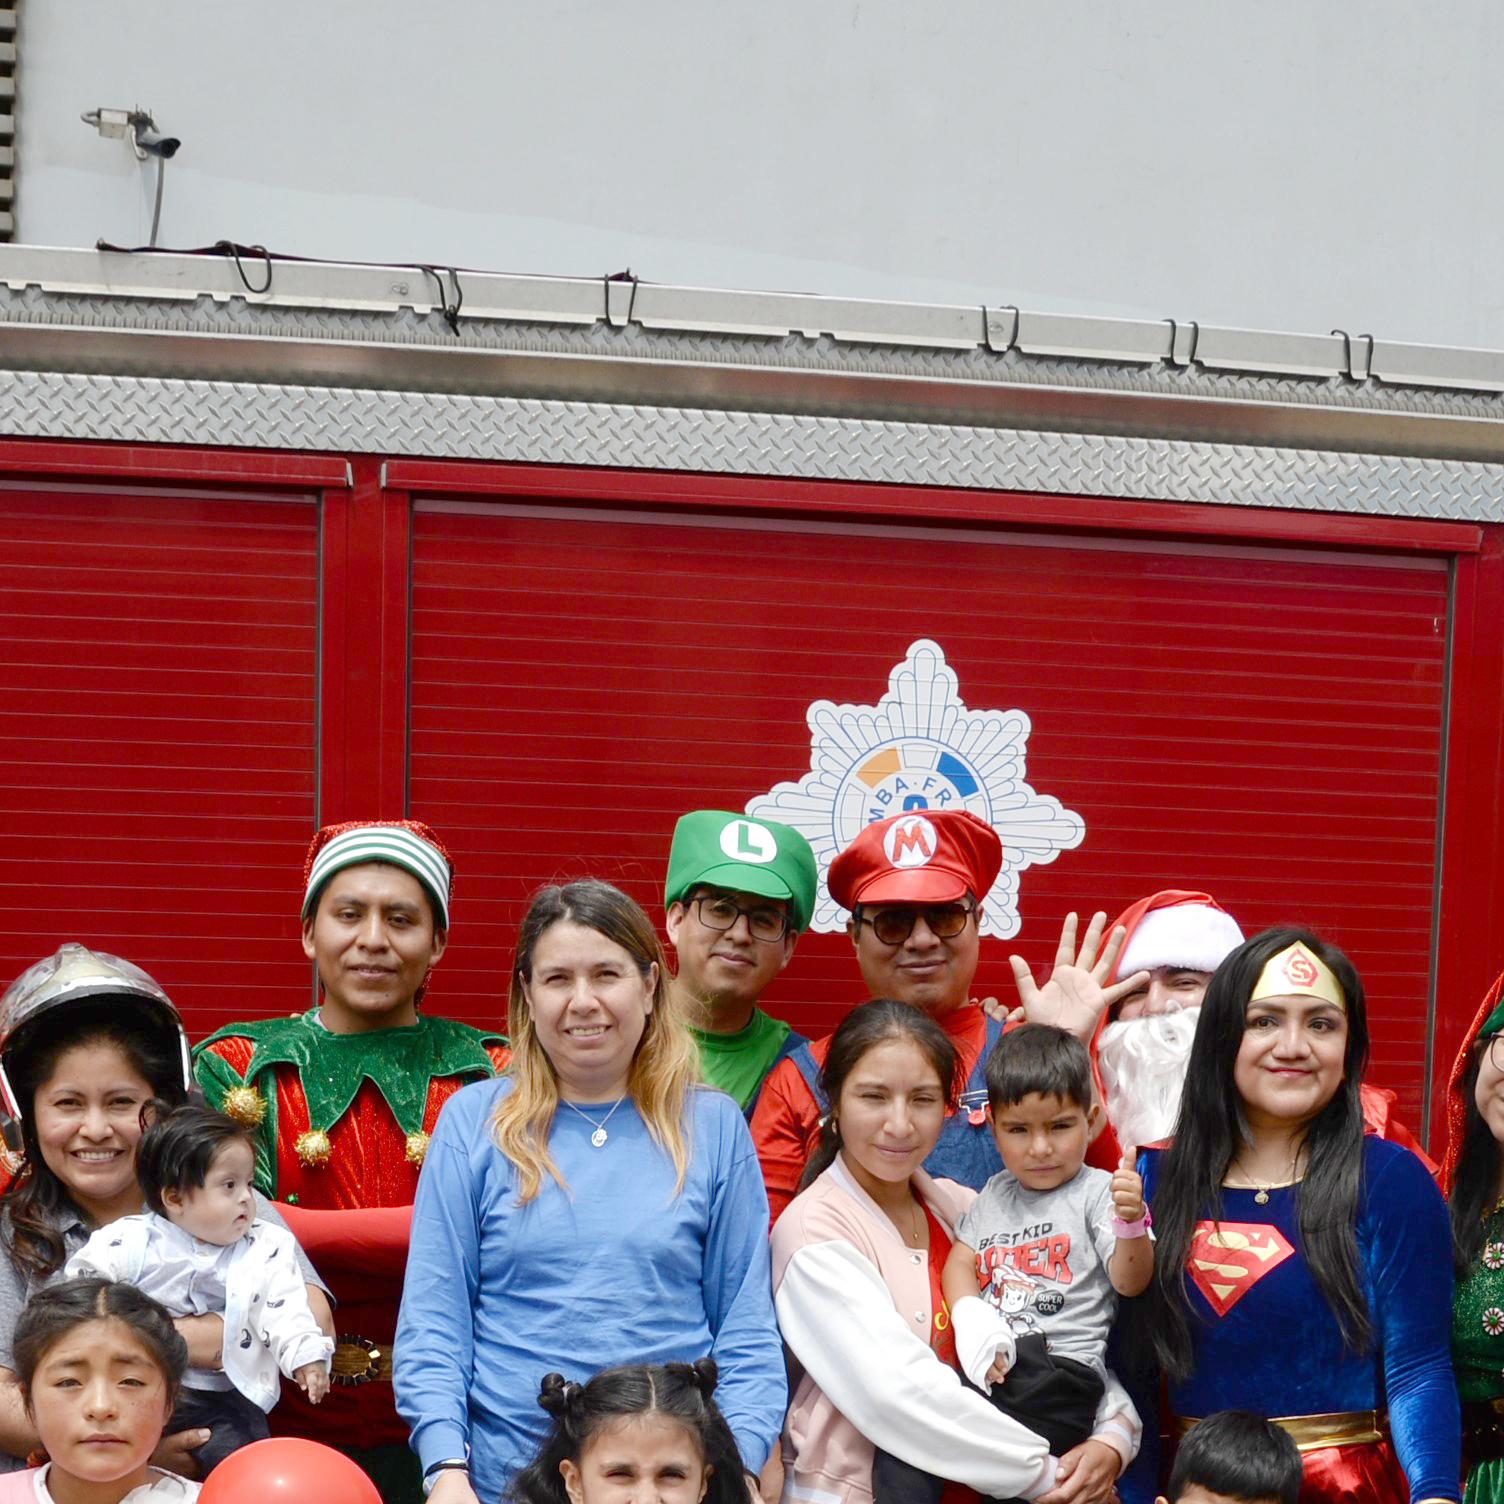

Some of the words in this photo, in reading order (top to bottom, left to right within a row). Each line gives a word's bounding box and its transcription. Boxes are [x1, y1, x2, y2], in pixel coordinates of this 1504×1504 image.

[868, 777, 910, 823] MBA
[738, 823, 763, 857] L
[892, 825, 932, 863] M
[979, 1233, 1021, 1251] BEST
[1022, 1222, 1054, 1240] KID
[1038, 1293, 1063, 1305] SUPER
[1038, 1302, 1059, 1313] COOL
